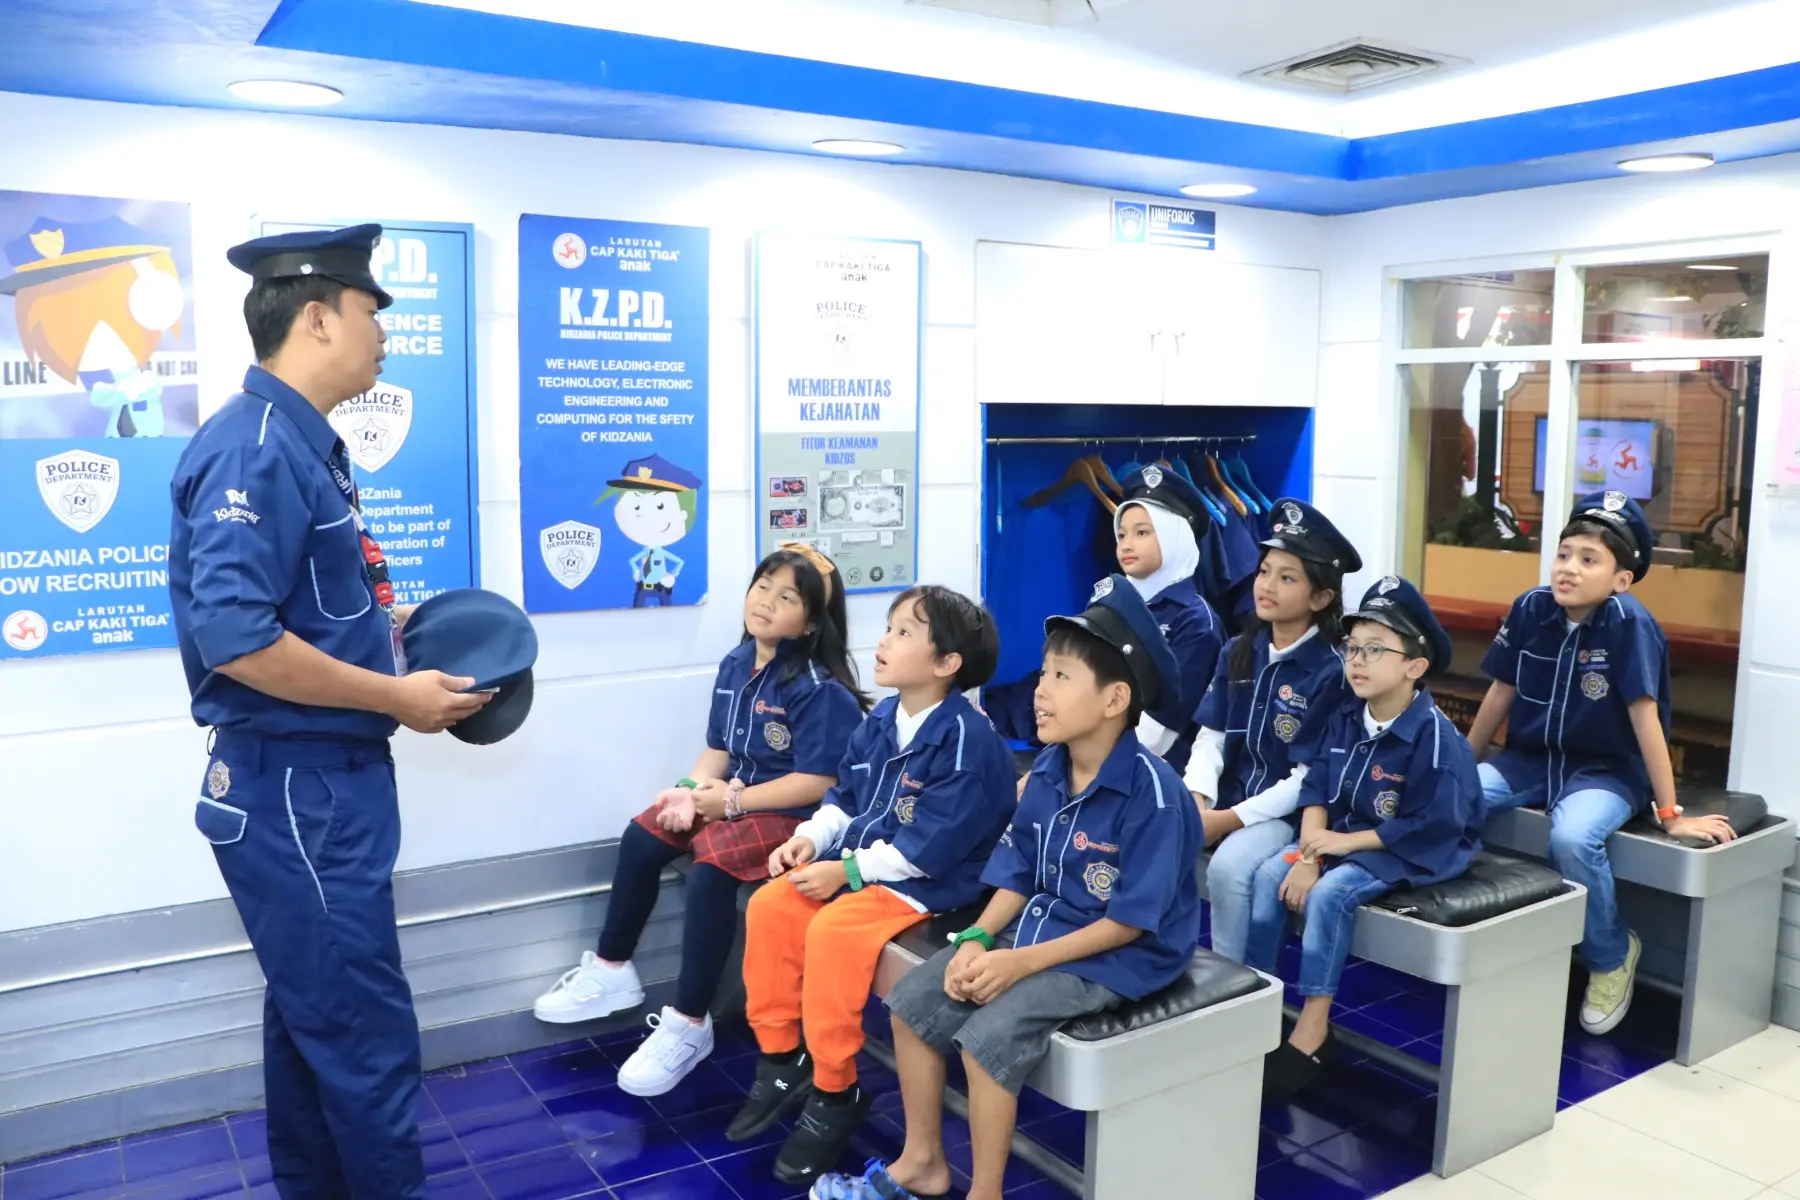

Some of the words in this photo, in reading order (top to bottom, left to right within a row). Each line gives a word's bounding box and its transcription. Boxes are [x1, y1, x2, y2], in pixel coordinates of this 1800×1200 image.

[1151, 207, 1195, 225] UNIFORMS
[610, 237, 662, 248] LARUTAN
[590, 246, 614, 257] CAP
[617, 247, 646, 259] KAKI
[619, 260, 651, 272] anak
[868, 263, 891, 272] TIGA
[841, 272, 867, 282] anak
[560, 286, 672, 329] K.Z.P.D.
[816, 300, 867, 315] POLICE
[560, 329, 597, 340] KIDZANIA
[597, 330, 624, 341] POLICE
[624, 331, 672, 343] DEPARTMENT
[546, 358, 565, 370] WE
[568, 359, 599, 371] HAVE
[601, 360, 686, 372] LEADING-EDGE
[3, 361, 47, 385] LINE
[537, 377, 620, 390] TECHNOLOGY,
[622, 378, 693, 390] ELECTRONIC
[788, 378, 892, 397] MEMBERANTAS
[564, 395, 642, 407] ENGINEERING
[644, 396, 669, 407] AND
[335, 405, 405, 417] DEPARTMENT
[800, 402, 880, 421] KEJAHATAN
[536, 413, 606, 425] COMPUTING
[609, 414, 633, 425] FOR
[635, 414, 657, 425] THE
[659, 414, 694, 425] SFETY
[581, 431, 597, 442] OF
[600, 432, 653, 443] KIDZANIA
[801, 436, 826, 450] FITUR
[828, 436, 878, 449] KEAMANAN
[825, 452, 856, 465] KIDZOS
[46, 461, 111, 476] POLICE
[44, 473, 113, 485] DEPARTMENT
[371, 522, 385, 533] to
[388, 521, 405, 533] be
[408, 520, 434, 535] part
[437, 519, 451, 531] of
[431, 535, 446, 548] of
[547, 530, 595, 543] POLICE
[546, 540, 596, 550] DEPARTMENT
[0, 576, 40, 595] OW
[46, 570, 169, 592] RECRUITIN
[392, 580, 425, 590] UTAN
[77, 604, 145, 617] LARUTAN
[52, 620, 84, 633] CAP
[88, 617, 126, 631] KAKI
[92, 630, 134, 644] anak
